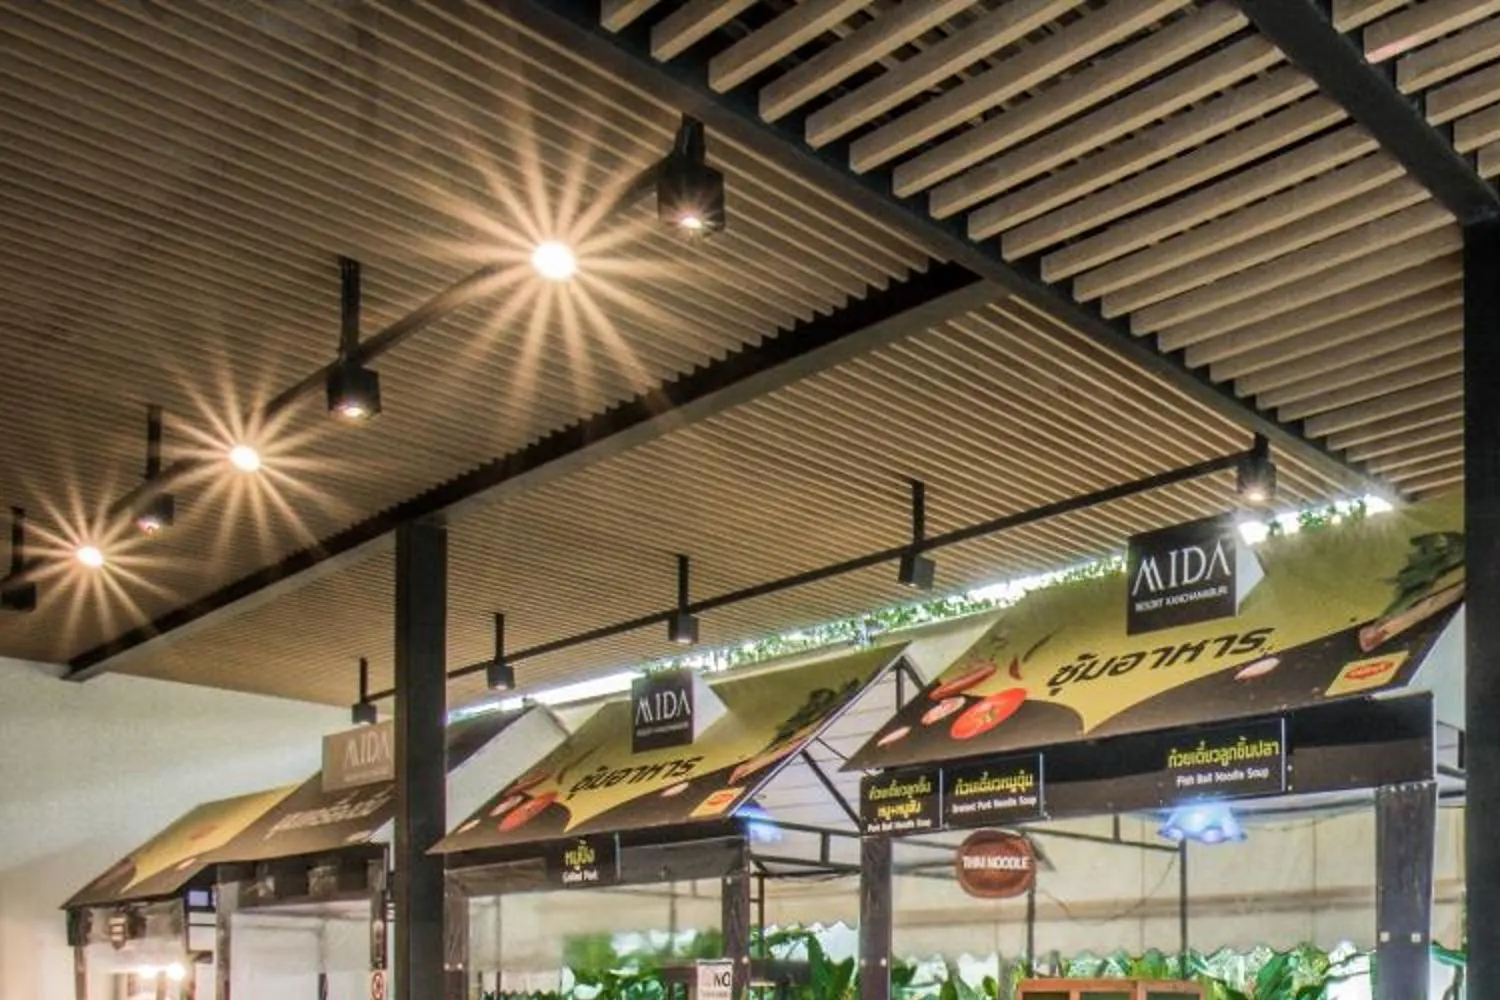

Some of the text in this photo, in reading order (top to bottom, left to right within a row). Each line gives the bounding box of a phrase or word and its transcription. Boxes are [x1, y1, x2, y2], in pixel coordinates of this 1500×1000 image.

[1131, 540, 1232, 596] MIDA
[635, 688, 691, 726] MIDA
[987, 856, 1030, 870] NOODLE
